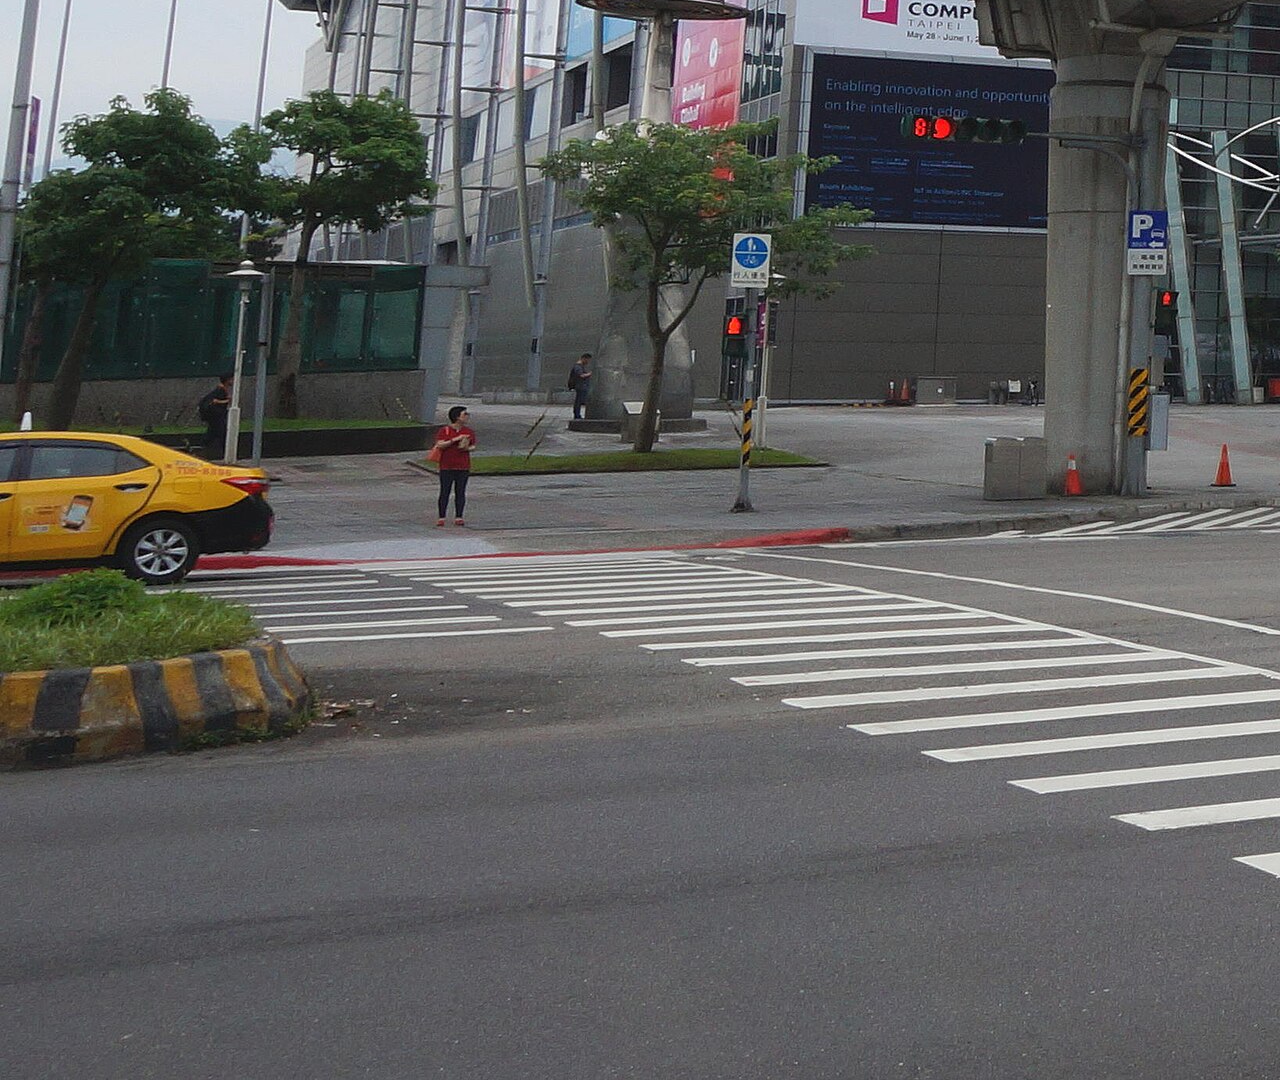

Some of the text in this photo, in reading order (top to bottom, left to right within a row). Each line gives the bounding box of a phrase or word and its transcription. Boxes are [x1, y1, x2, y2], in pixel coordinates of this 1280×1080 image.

[908, 19, 961, 30] TAIPEI
[907, 30, 923, 40] May
[925, 32, 936, 40] 28
[943, 33, 964, 41] June
[826, 78, 881, 96] Enabling
[885, 82, 951, 97] innovation
[955, 88, 978, 99] and
[824, 100, 969, 118] on the intelligent edge
[1132, 214, 1154, 239] P
